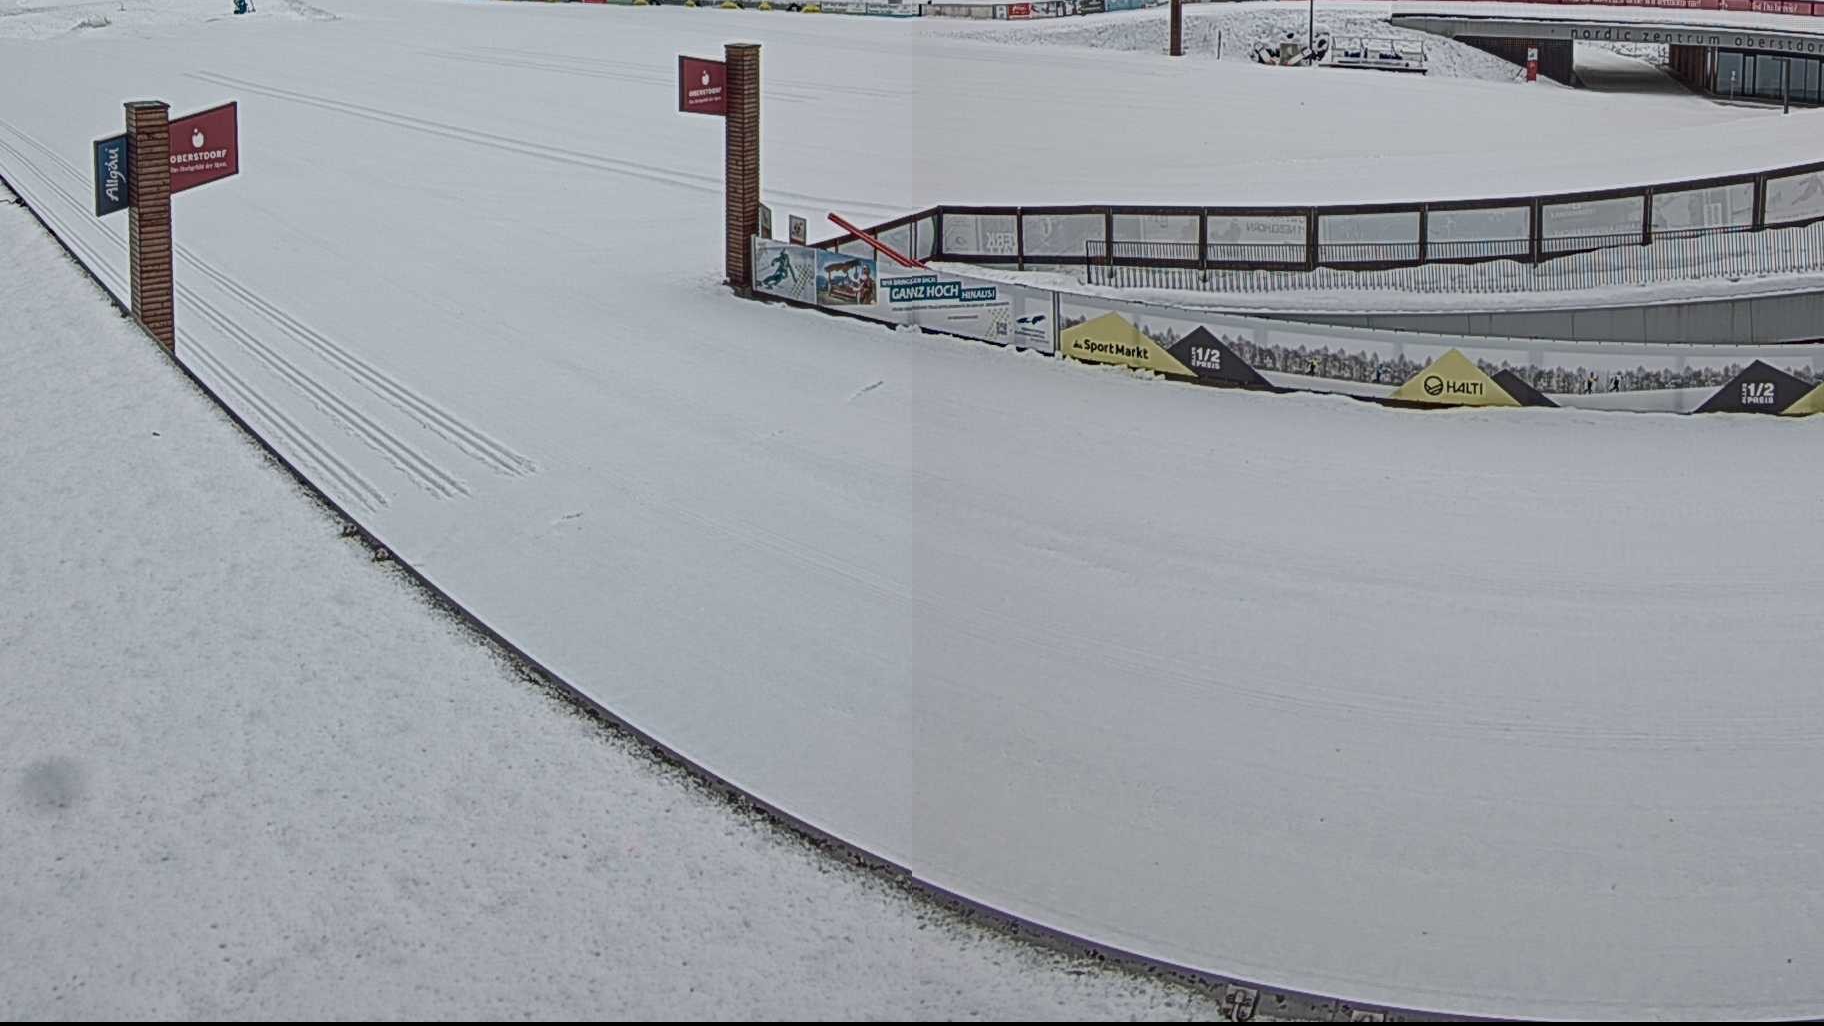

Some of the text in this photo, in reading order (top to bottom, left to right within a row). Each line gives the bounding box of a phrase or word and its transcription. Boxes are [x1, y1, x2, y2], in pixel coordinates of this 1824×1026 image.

[1571, 28, 1632, 40] nordic
[1643, 32, 1720, 45] zentrum
[170, 149, 227, 164] OBERSTDORF
[926, 284, 960, 298] HOCH
[1196, 347, 1221, 363] 1/2
[1446, 380, 1483, 395] HALTI
[1747, 383, 1775, 396] 1/2
